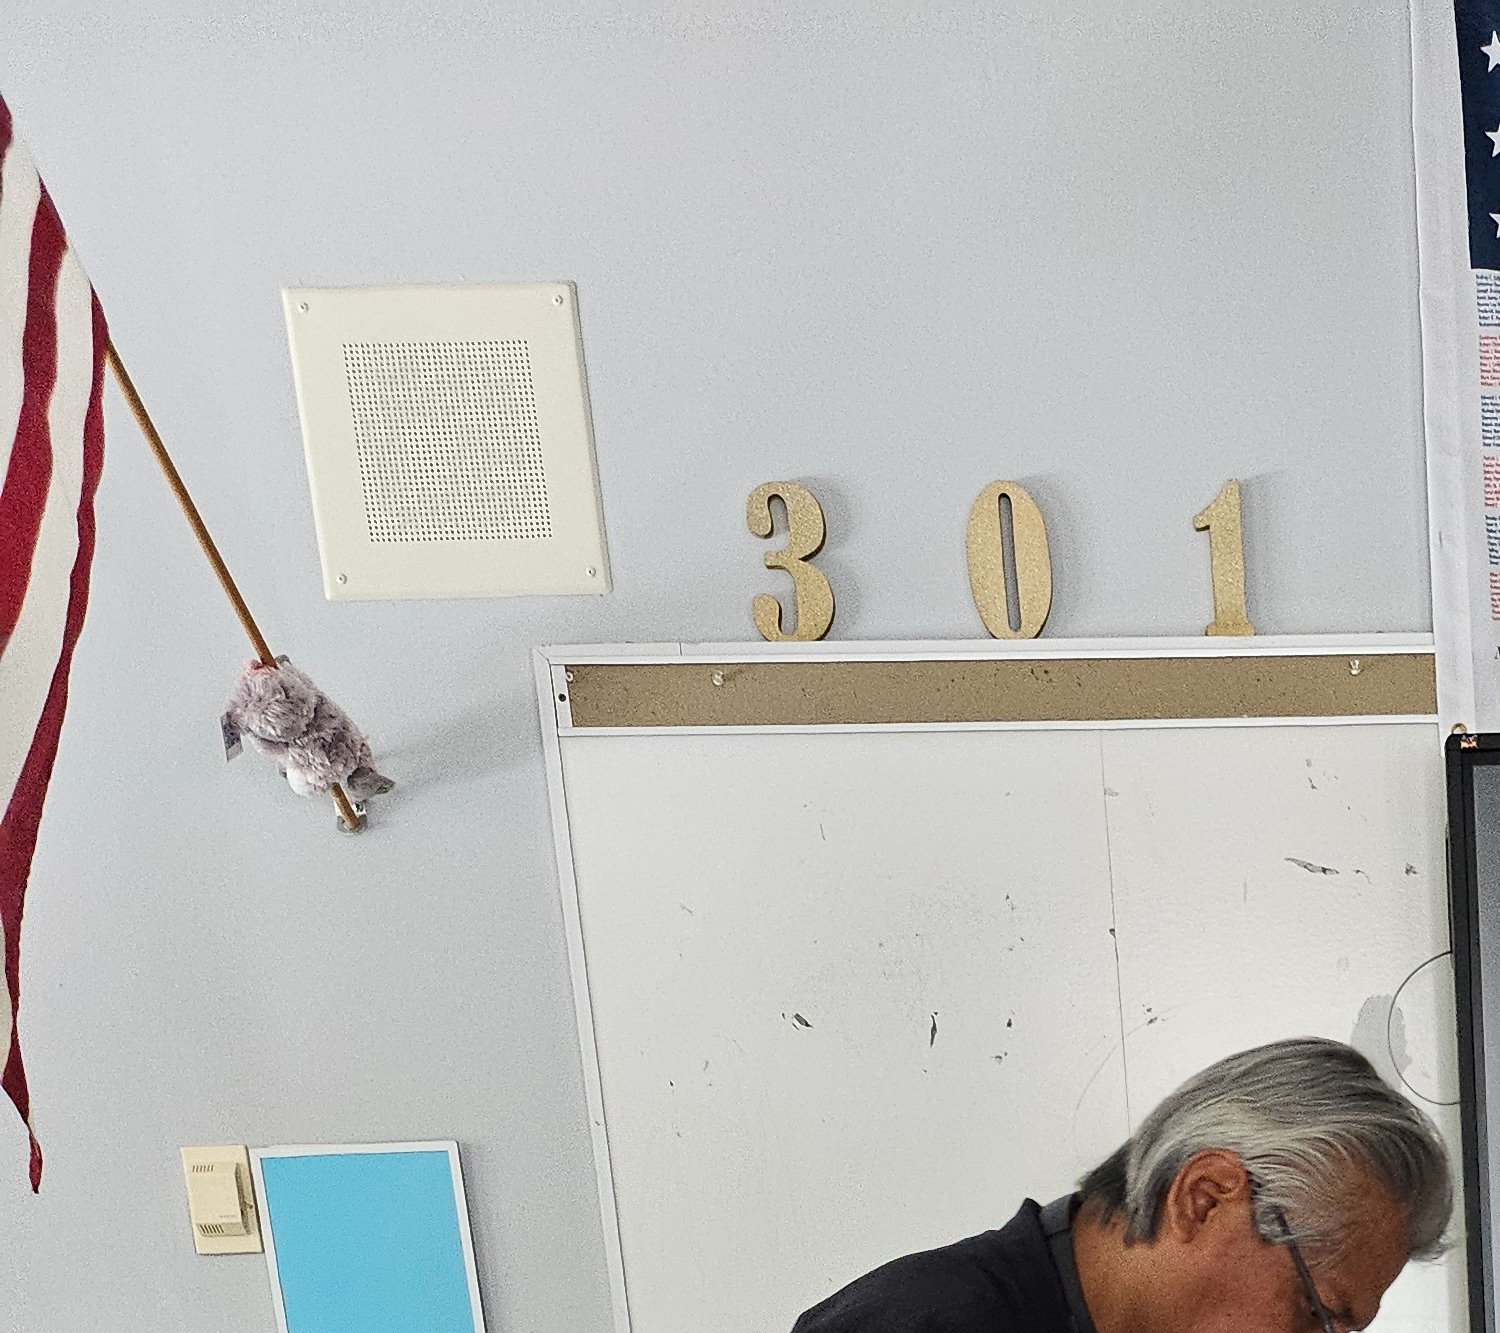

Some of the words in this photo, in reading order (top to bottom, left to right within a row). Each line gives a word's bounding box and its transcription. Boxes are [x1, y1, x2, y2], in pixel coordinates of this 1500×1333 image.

[746, 481, 836, 641] 3
[967, 479, 1053, 639] 0
[1193, 478, 1256, 637] 1
